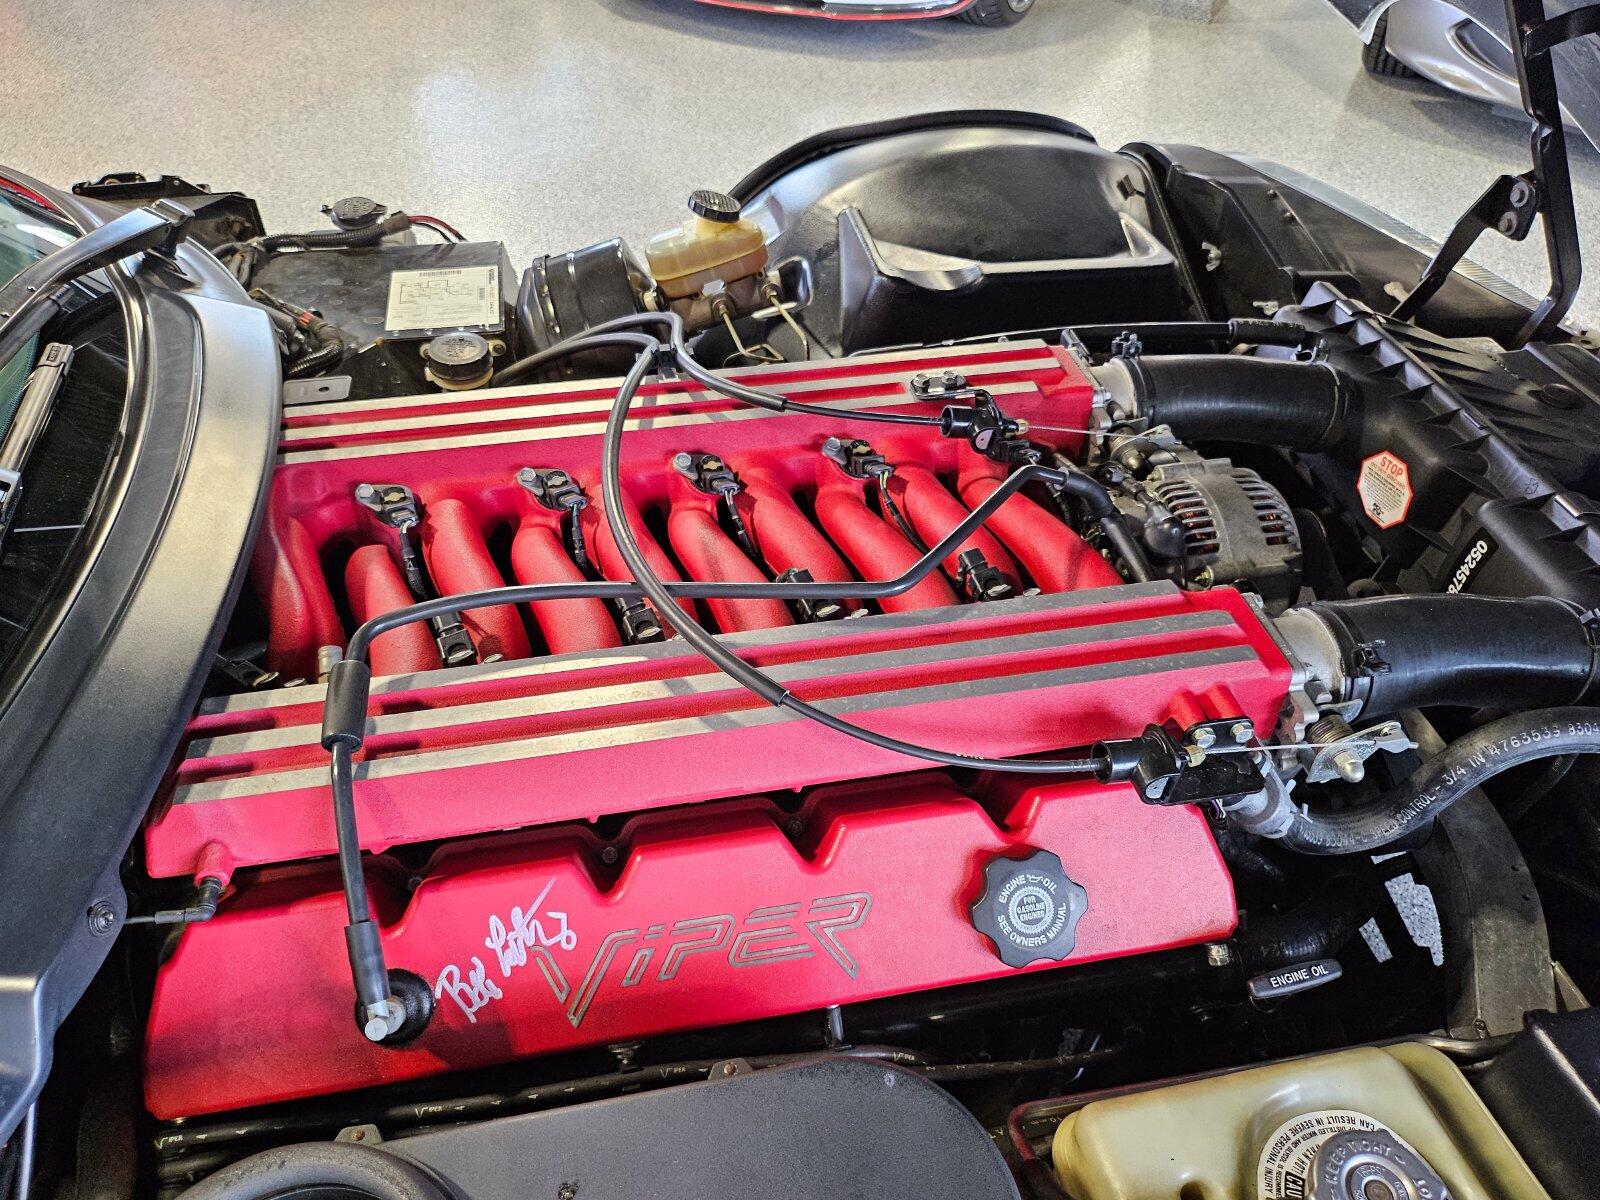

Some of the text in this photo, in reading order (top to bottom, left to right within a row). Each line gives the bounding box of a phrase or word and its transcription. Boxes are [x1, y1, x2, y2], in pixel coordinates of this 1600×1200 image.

[1380, 456, 1404, 477] STOP
[1446, 540, 1488, 594] 0524576
[1397, 793, 1437, 823] CONTROL
[1441, 765, 1467, 785] 3/4
[1468, 752, 1486, 768] IN
[998, 874, 1027, 904] ENGINE
[1042, 878, 1058, 895] OIL
[1023, 895, 1036, 905] FOR
[1016, 902, 1046, 914] GASOLINE
[1020, 910, 1045, 922] ENGINES
[997, 915, 1012, 935] SEE
[1009, 932, 1048, 947] OWNERS
[1046, 902, 1067, 940] MANUAL
[529, 890, 874, 1029] VIPER
[1270, 964, 1329, 988] ENGINE OIL
[1293, 1139, 1302, 1149] AND
[1302, 1129, 1319, 1142] WATER
[1264, 1115, 1375, 1194] CAN RESULT IN SEVERE PERSONAL INJURY
[1279, 1145, 1294, 1164] GLYCOL
